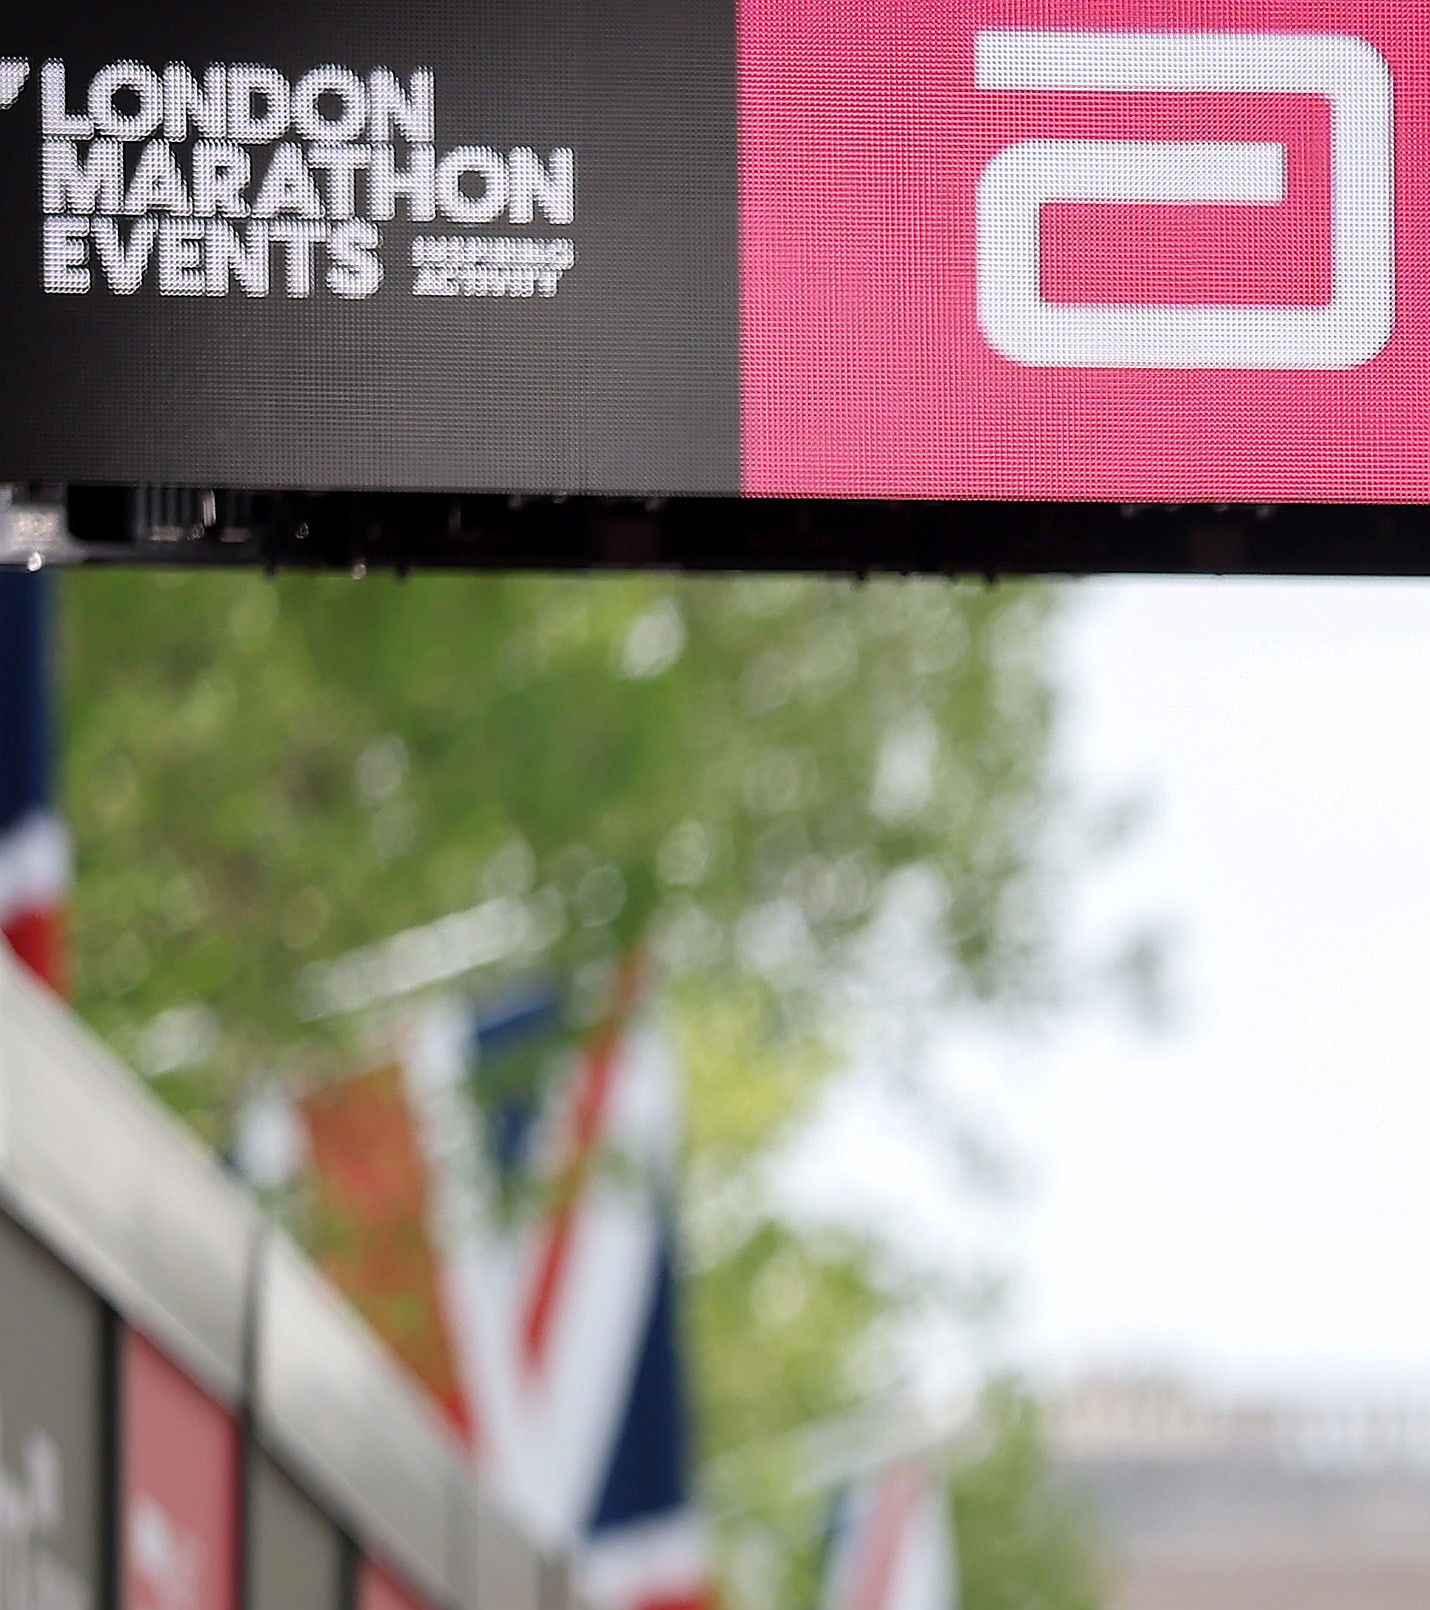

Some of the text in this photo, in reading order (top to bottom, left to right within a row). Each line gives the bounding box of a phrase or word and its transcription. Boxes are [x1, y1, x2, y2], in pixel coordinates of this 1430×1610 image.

[40, 57, 435, 143] LONDON
[40, 138, 574, 224] MARATHON
[41, 215, 384, 299] EVENTS
